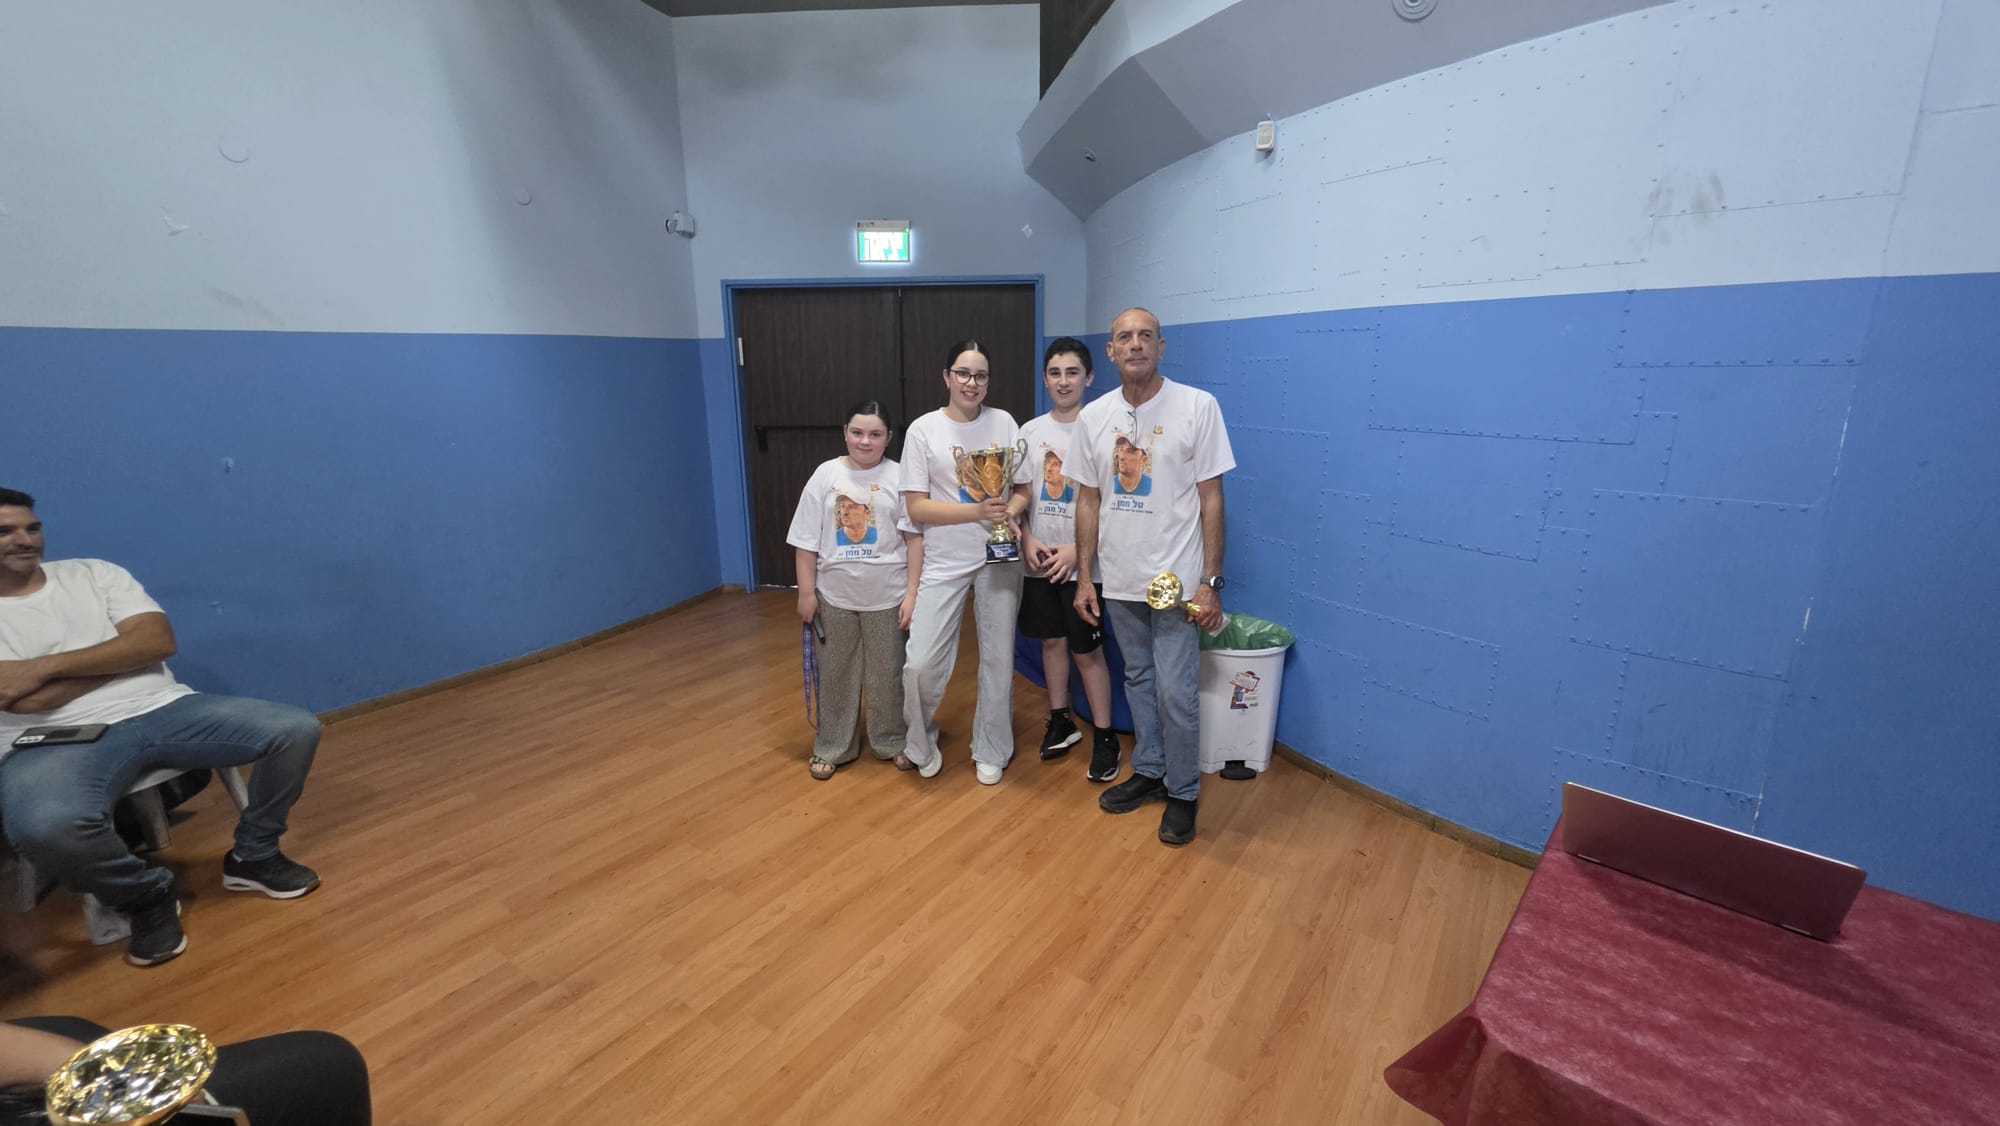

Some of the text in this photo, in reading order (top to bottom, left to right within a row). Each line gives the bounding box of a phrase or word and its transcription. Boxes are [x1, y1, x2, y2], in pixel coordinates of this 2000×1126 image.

[1117, 500, 1130, 510] ממן
[1132, 499, 1144, 509] טל
[845, 550, 860, 559] ממן
[861, 548, 872, 556] טל
